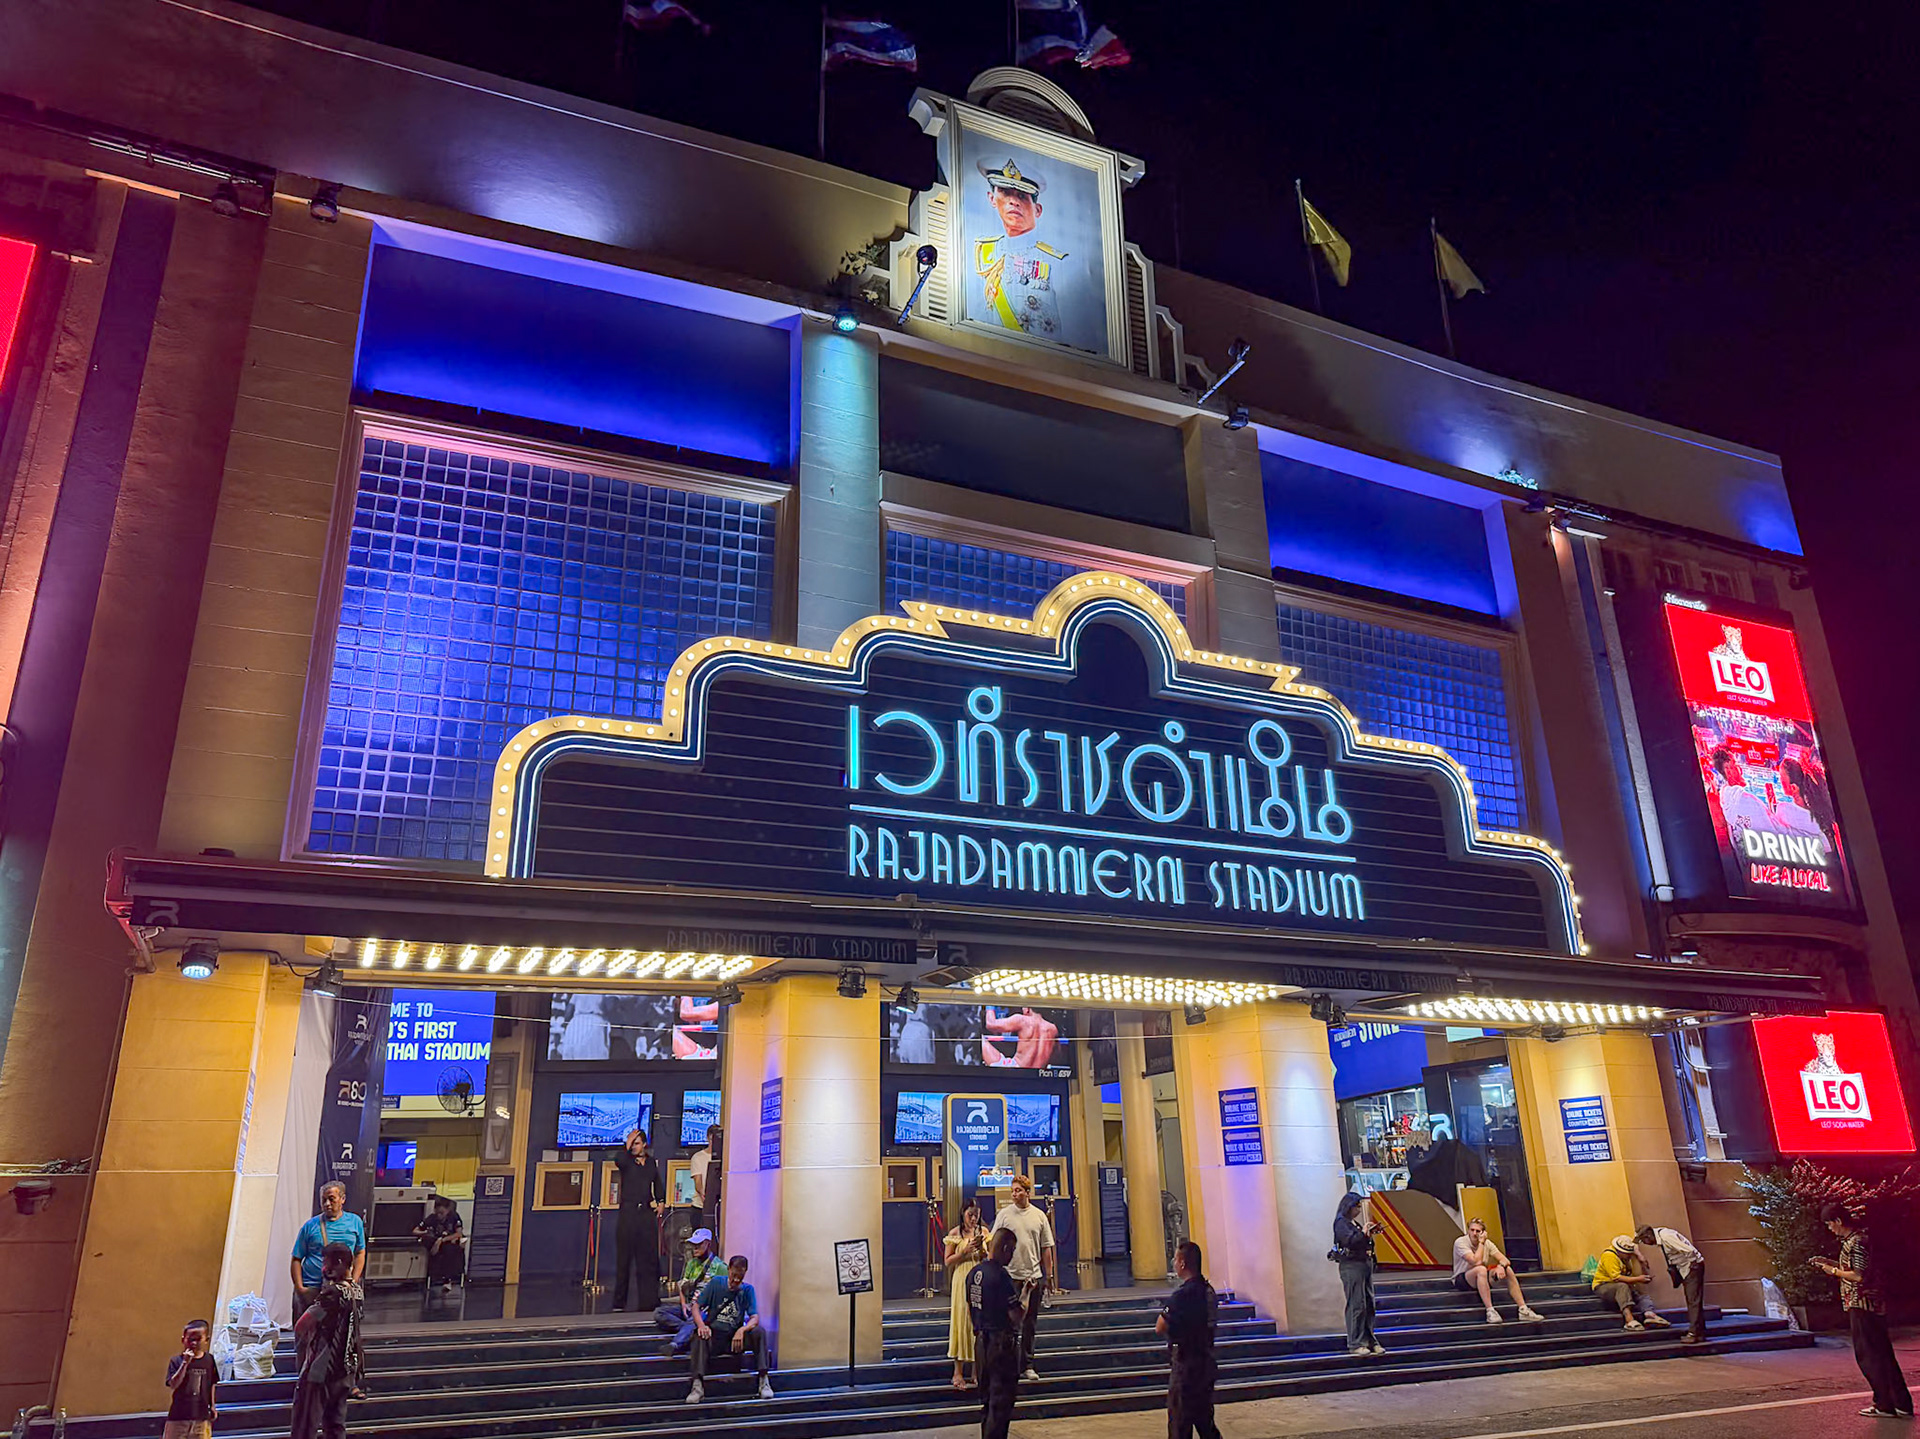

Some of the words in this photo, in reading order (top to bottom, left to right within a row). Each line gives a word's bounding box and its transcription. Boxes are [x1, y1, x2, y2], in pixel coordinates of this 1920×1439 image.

[1716, 659, 1765, 692] LEO
[850, 686, 1353, 844] เวทีราชดำเนิน
[1743, 828, 1826, 867] DRINK
[849, 824, 1185, 905] RAJADAMNERN
[1209, 861, 1365, 921] STADIUM
[1751, 862, 1778, 885] LIKE
[1780, 867, 1791, 888] A
[1792, 867, 1831, 892] LOCAL
[666, 930, 817, 957] RAJADAMNERN
[832, 937, 908, 962] STADIUM
[1284, 967, 1389, 989] RAJADAMNERN
[416, 1003, 434, 1018] TO
[414, 1021, 457, 1040] FIRST
[387, 1042, 420, 1061] THAI
[424, 1042, 491, 1061] STADIUM
[1039, 1069, 1053, 1078] Plan
[1808, 1079, 1861, 1111] LEO
[1240, 1102, 1257, 1111] TICKETS
[1583, 1109, 1602, 1117] TICKETS
[1244, 1142, 1261, 1150] TICKETS
